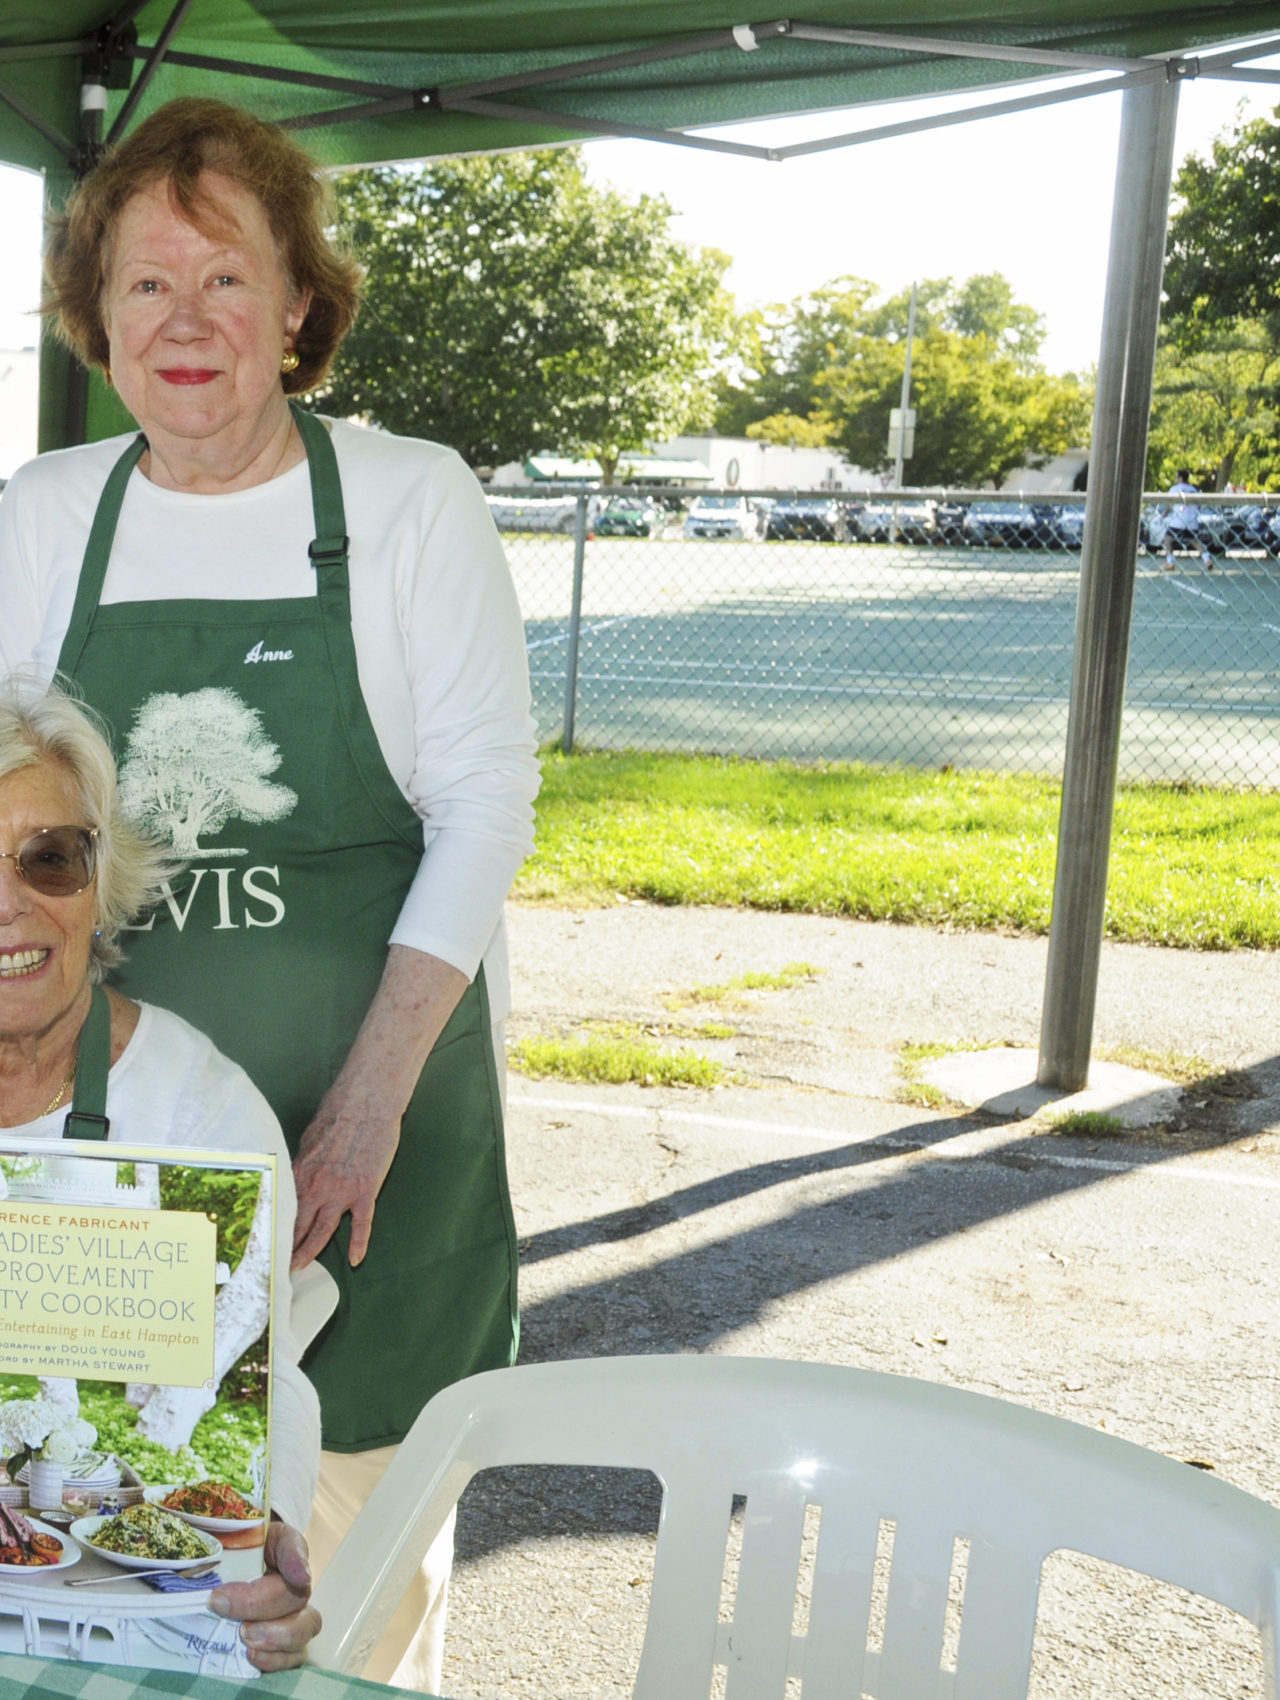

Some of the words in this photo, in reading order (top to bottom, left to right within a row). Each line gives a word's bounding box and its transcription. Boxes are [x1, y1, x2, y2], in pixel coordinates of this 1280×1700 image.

[244, 640, 294, 664] Anne
[59, 1216, 150, 1231] FABRICANT
[78, 1236, 190, 1269] VILLAGE
[40, 1291, 197, 1323] COOKBOOK
[83, 1326, 96, 1339] in
[101, 1327, 132, 1342] East
[137, 1330, 200, 1350] Hampton
[45, 1344, 57, 1352] BY
[61, 1344, 98, 1356] DOUG
[101, 1347, 146, 1360] YOUNG
[38, 1356, 89, 1369] MARTHA
[93, 1360, 151, 1374] STEWART
